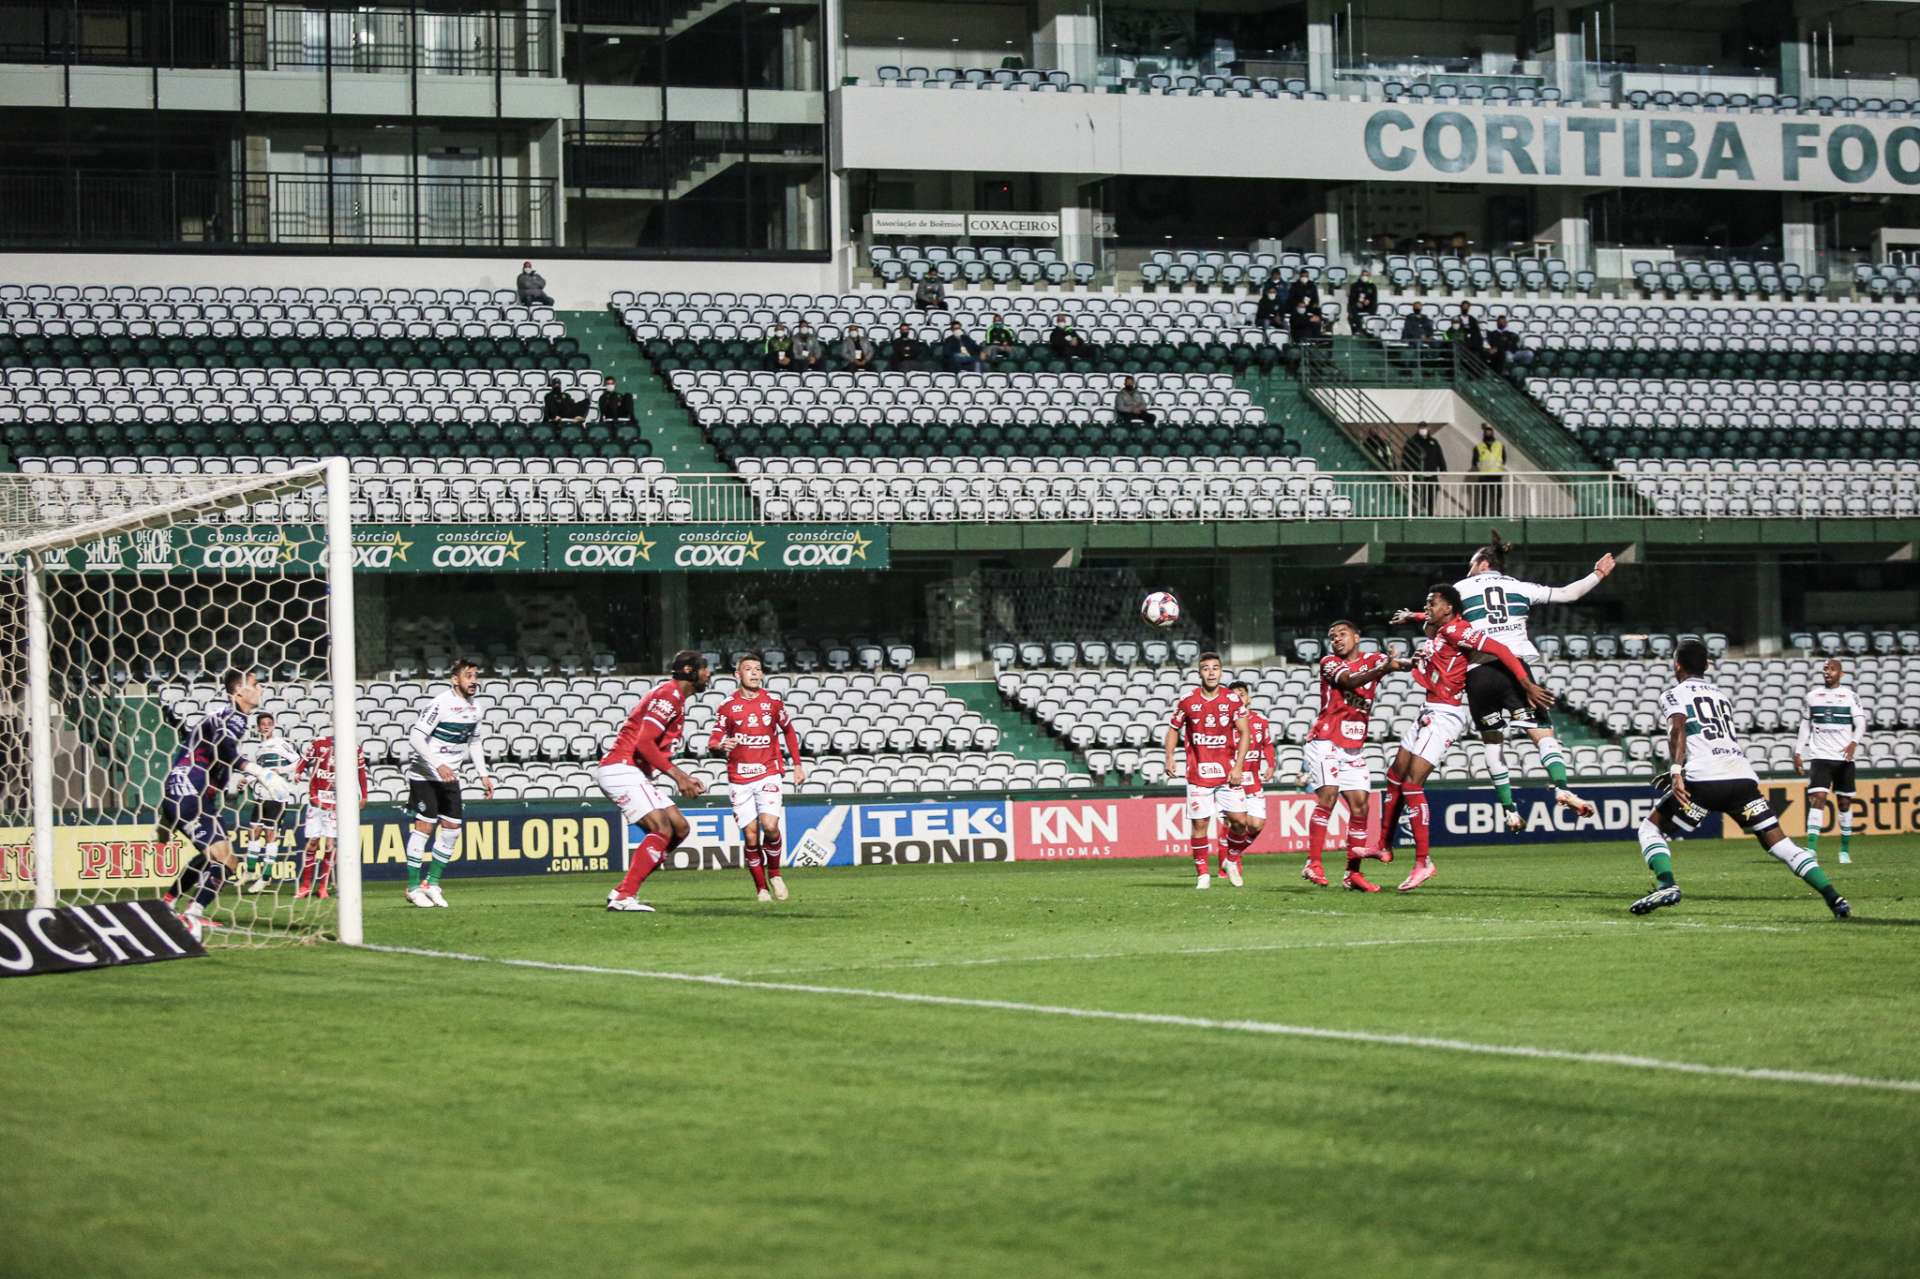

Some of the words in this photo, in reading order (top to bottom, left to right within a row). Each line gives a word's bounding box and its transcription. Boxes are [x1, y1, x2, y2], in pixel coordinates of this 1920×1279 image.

[1363, 108, 1755, 182] CORITIBA
[970, 220, 1058, 232] COXACEIROS
[323, 530, 395, 542] csórcio
[436, 530, 508, 542] consórcio
[568, 530, 639, 542] consórcio
[678, 530, 748, 542] consórcio
[787, 529, 855, 542] consórcio
[137, 543, 172, 563] SHOP
[319, 544, 394, 568] cxa
[1484, 586, 1509, 625] 9
[734, 732, 771, 746] Rizzo
[1192, 732, 1227, 745] Rizzo
[867, 807, 998, 836] TEK
[1031, 804, 1119, 846] KNN
[227, 830, 296, 847] PEA
[860, 837, 1008, 865] BOND
[1040, 846, 1112, 857] IDIOMAS
[547, 857, 609, 872] .COM.BR
